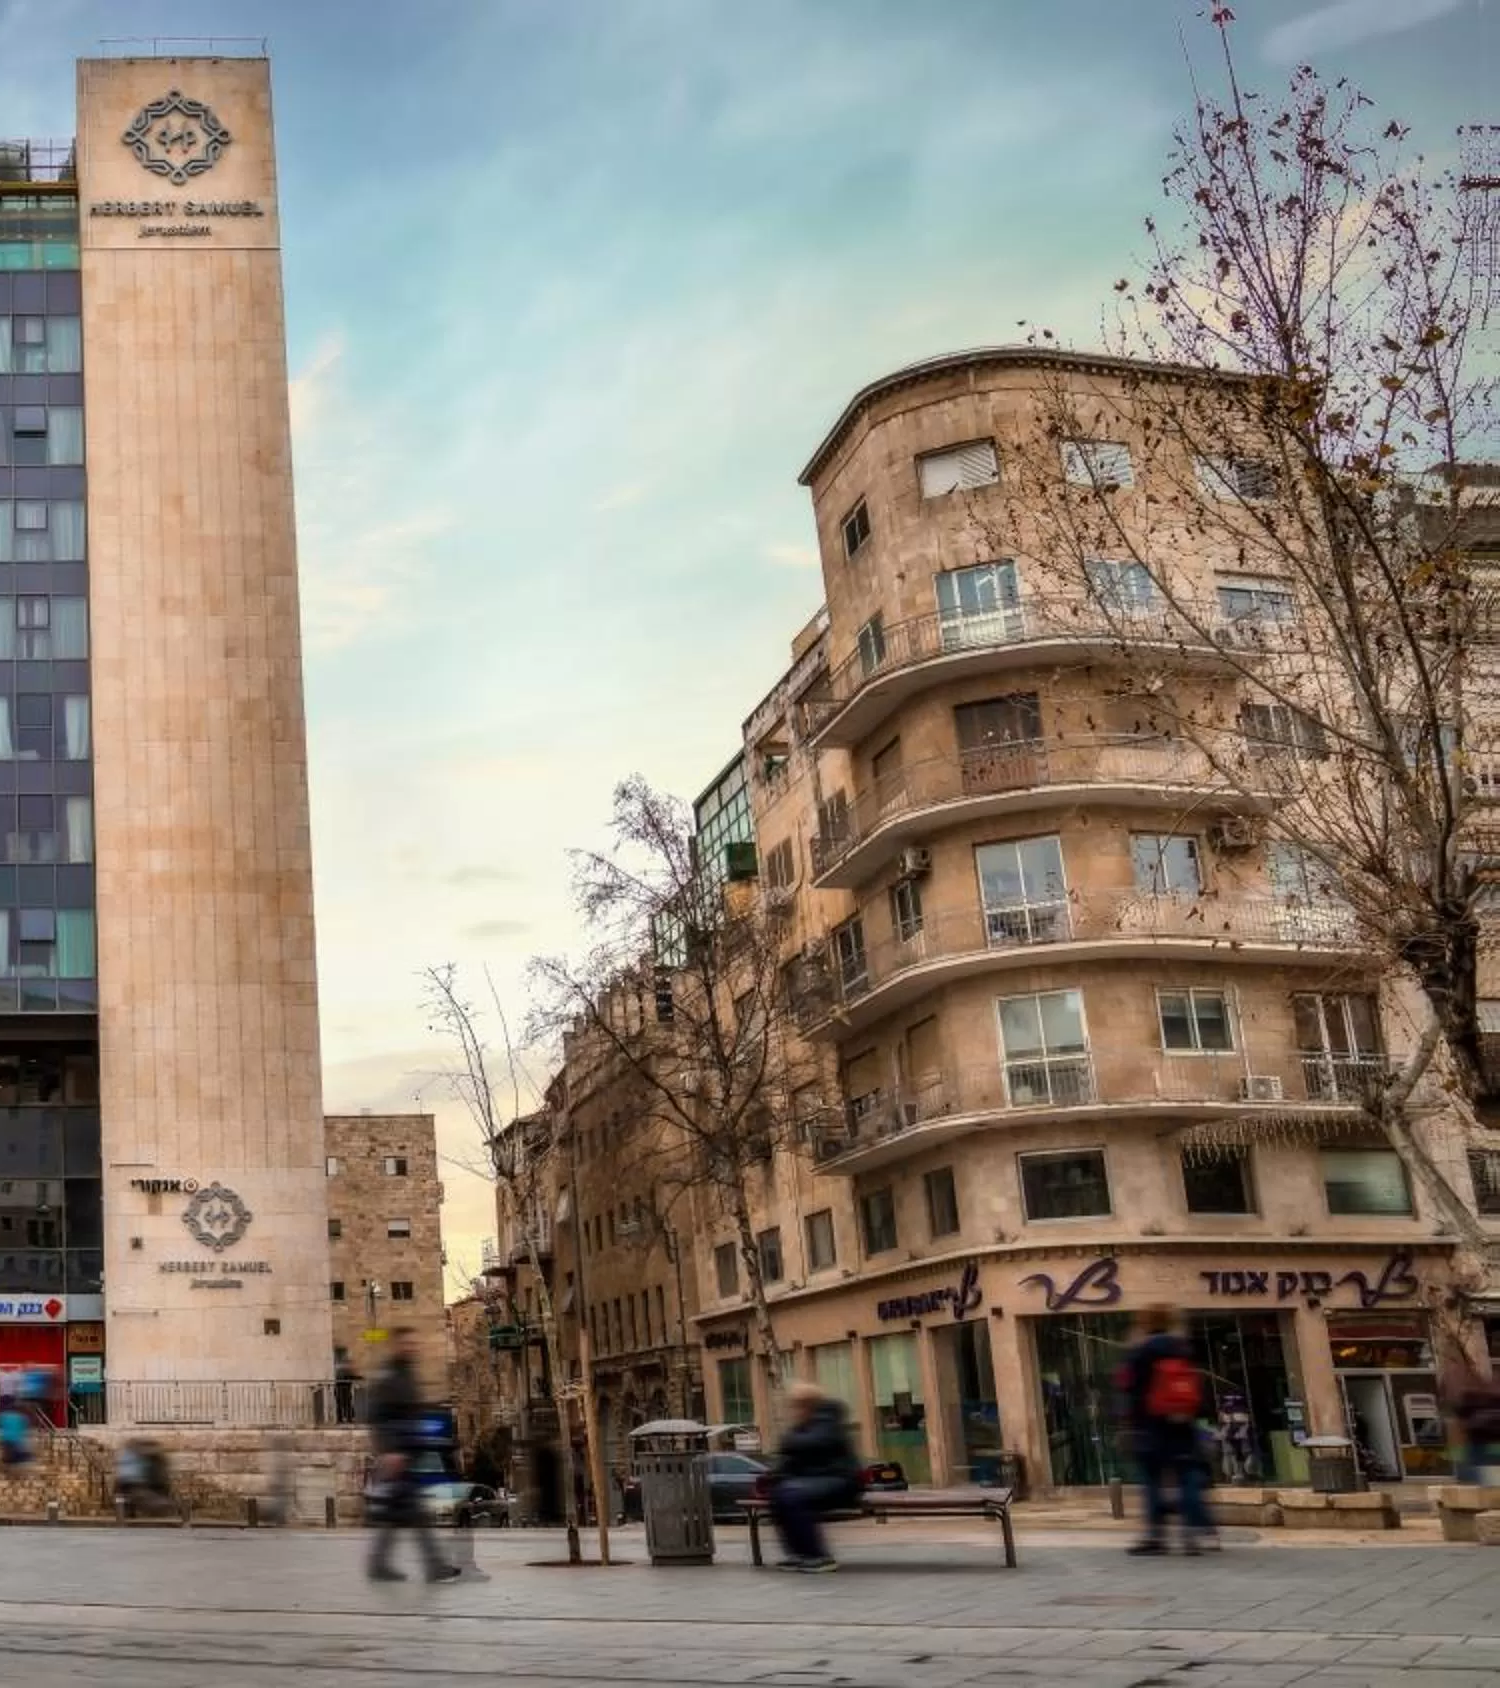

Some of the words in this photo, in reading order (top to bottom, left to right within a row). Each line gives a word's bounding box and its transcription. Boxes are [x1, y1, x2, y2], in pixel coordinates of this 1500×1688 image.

[90, 200, 176, 218] HERBERT
[183, 200, 264, 218] SAMUEL
[131, 1179, 182, 1195] אנקורי
[159, 1260, 215, 1275] HERBERT
[221, 1260, 273, 1275] SAMUEL
[1275, 1271, 1333, 1300] בנק
[17, 1303, 43, 1317] בנק
